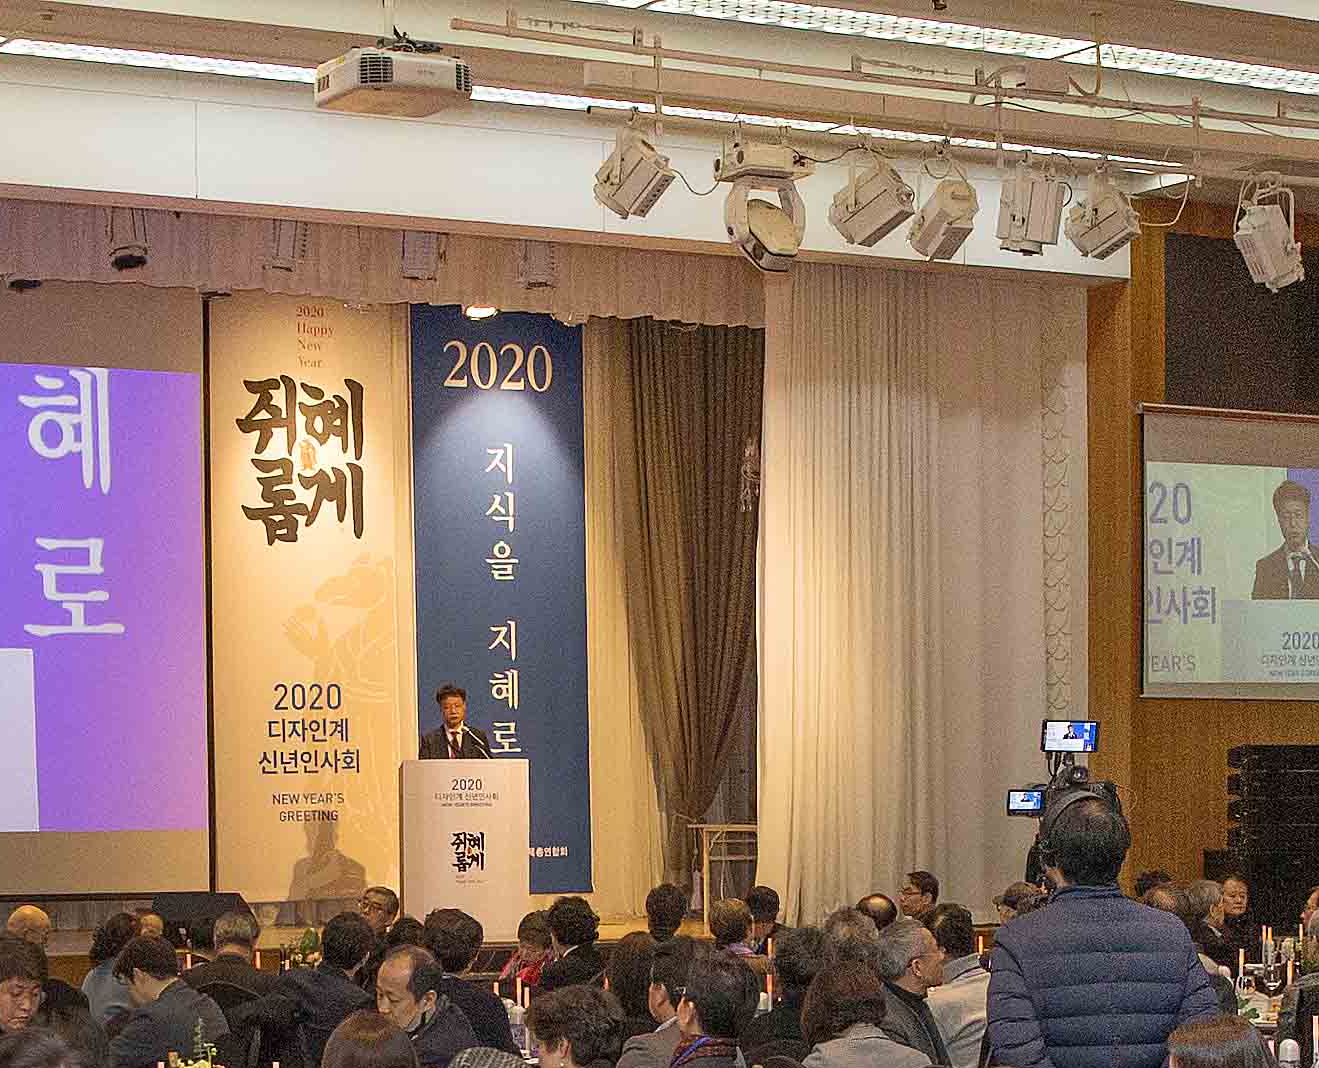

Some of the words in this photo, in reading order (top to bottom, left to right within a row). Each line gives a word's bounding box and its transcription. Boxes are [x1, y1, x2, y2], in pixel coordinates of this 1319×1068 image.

[296, 305, 325, 318] 2020
[297, 323, 335, 336] Happy
[297, 339, 321, 351] New
[297, 357, 323, 368] Year
[443, 341, 553, 392] 2020
[485, 443, 519, 580] 지식을
[1149, 481, 1192, 525] 20
[1149, 655, 1196, 672] EAR'S
[488, 619, 522, 756] 지혜로
[274, 684, 341, 710] 2020
[268, 718, 349, 743] 디자인계
[258, 749, 360, 774] 신년인사회
[451, 779, 483, 790] 2020
[272, 794, 298, 805] NEW
[303, 793, 344, 804] YEAR'S
[280, 811, 338, 822] GREETING
